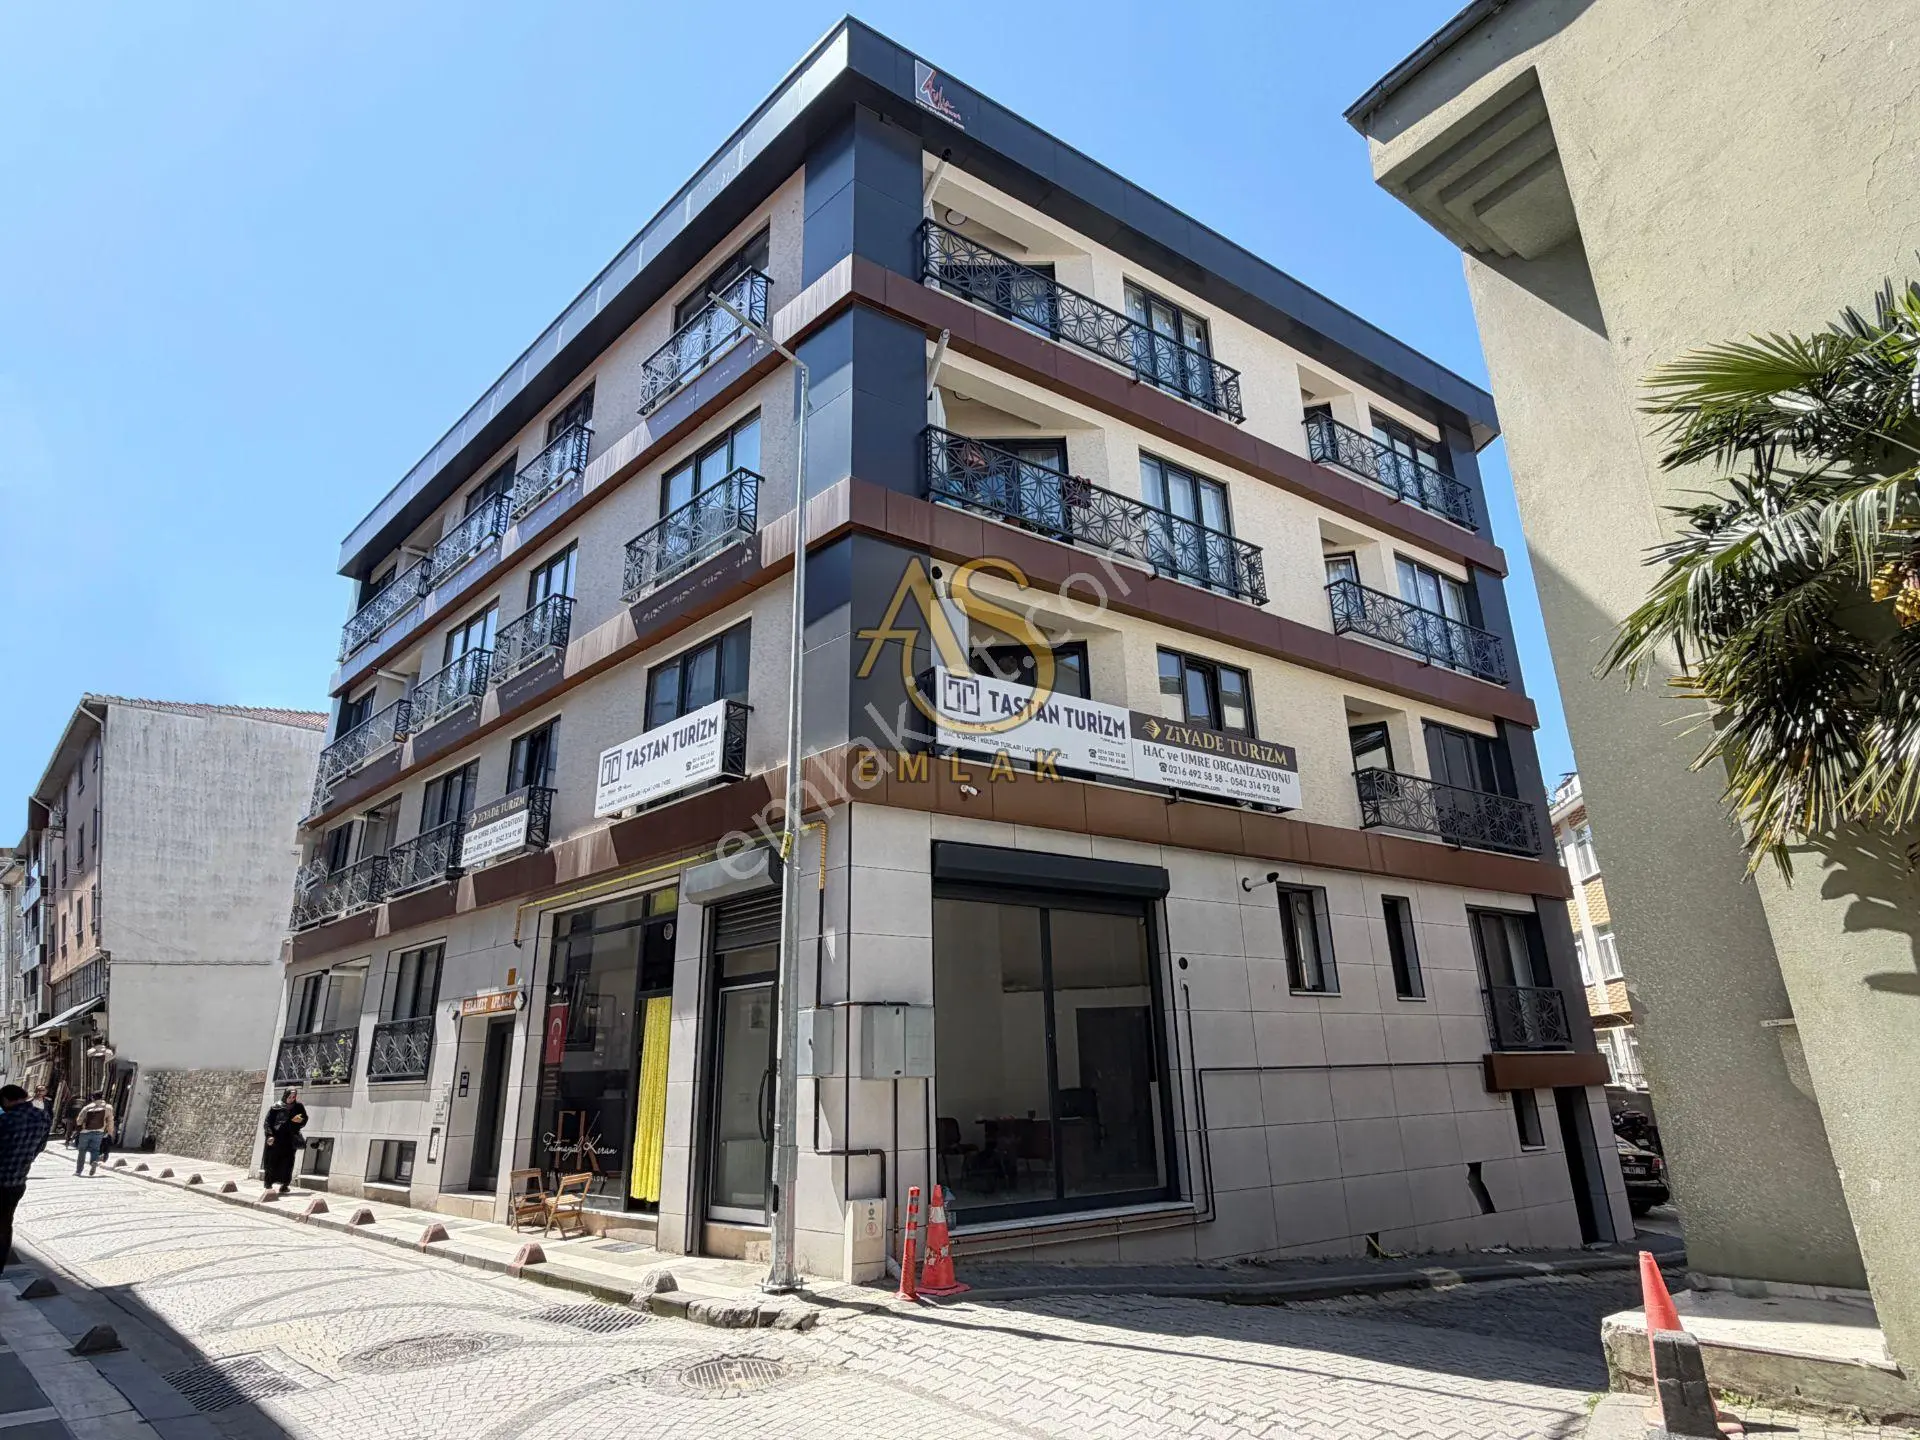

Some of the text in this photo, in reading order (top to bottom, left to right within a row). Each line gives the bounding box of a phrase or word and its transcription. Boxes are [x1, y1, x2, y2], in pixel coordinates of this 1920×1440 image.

[1063, 706, 1127, 740] TURİZM
[625, 734, 671, 772] TAŞTAN
[672, 713, 719, 752] TURİZM
[1167, 751, 1179, 762] ve
[1168, 765, 1187, 777] 0216
[1188, 769, 1202, 780] 492
[1204, 772, 1213, 782] 58
[1214, 773, 1224, 784] 58
[1230, 777, 1248, 789] 0542
[1248, 780, 1261, 791] 314
[1262, 783, 1271, 793] 92
